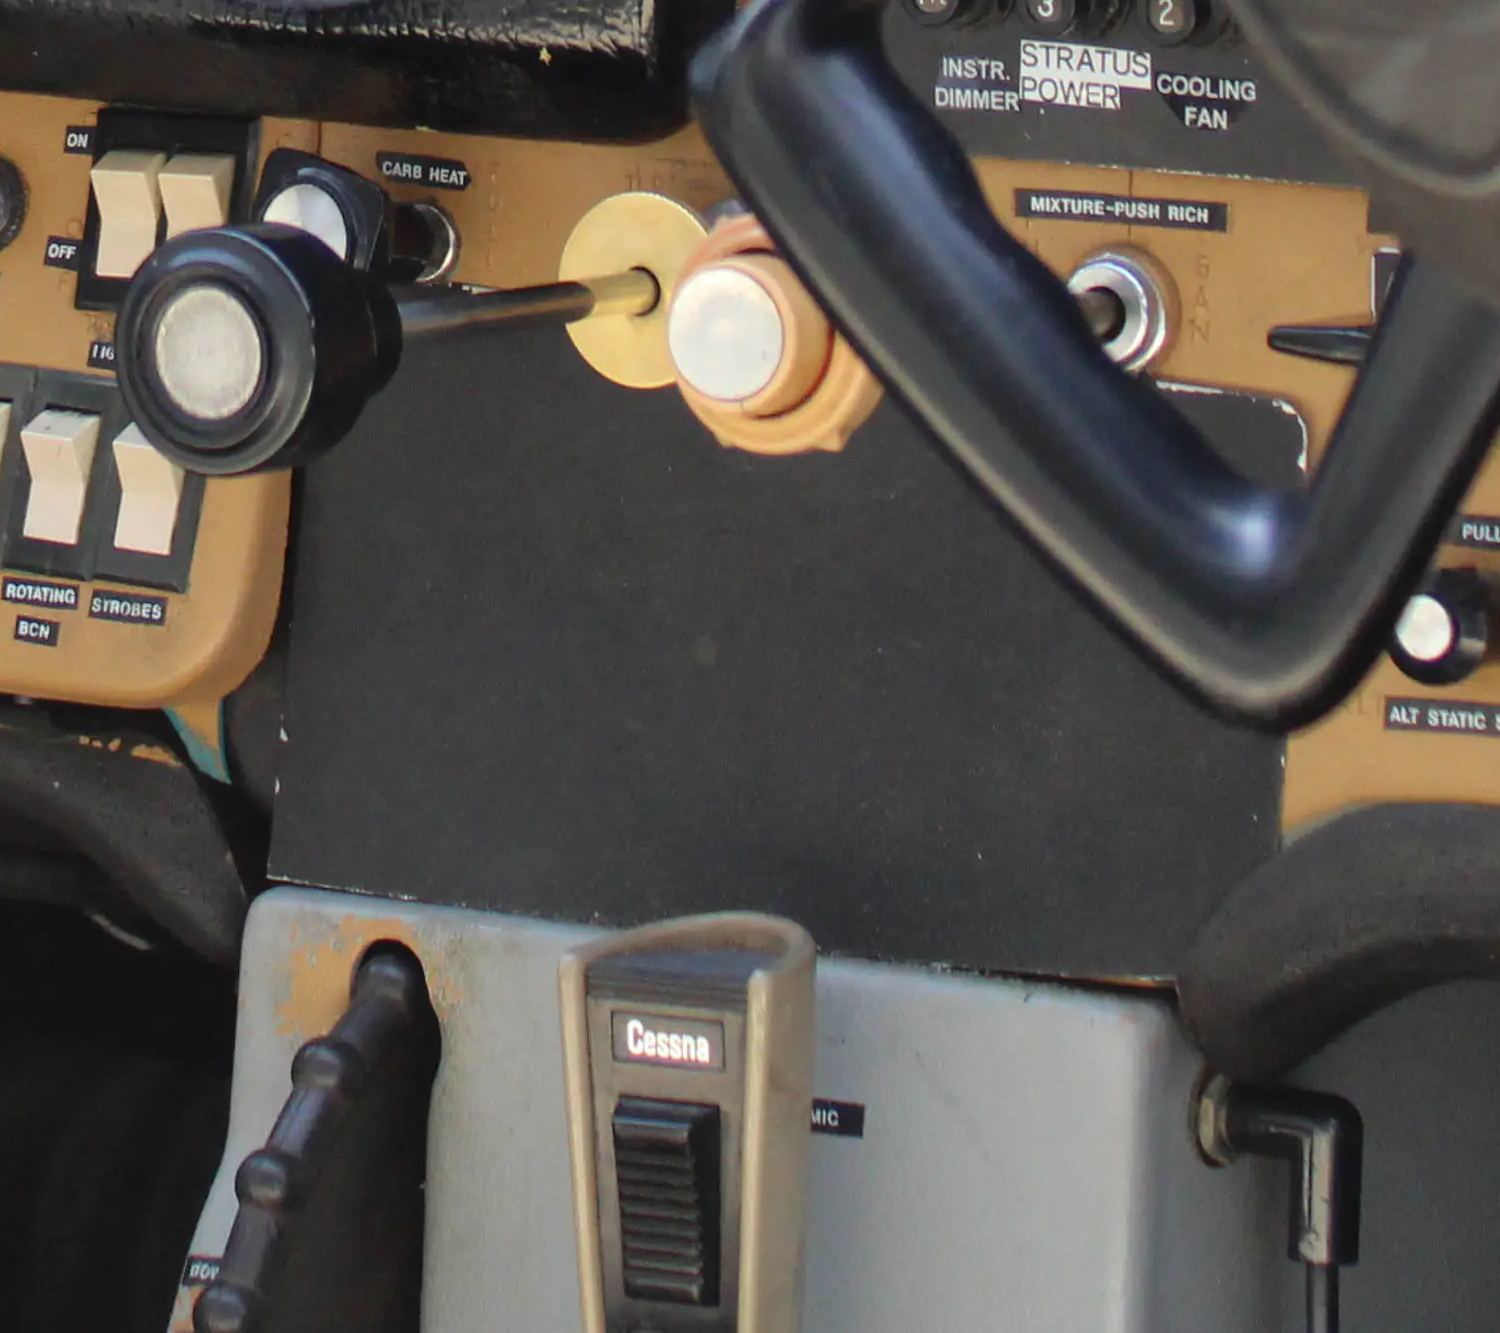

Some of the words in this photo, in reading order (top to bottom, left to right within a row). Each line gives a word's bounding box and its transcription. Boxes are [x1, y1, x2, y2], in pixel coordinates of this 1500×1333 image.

[942, 56, 1010, 82] INSTR.
[1021, 43, 1150, 77] STRATUS
[934, 85, 1020, 112] DIMMER
[1021, 76, 1121, 108] POWER
[1156, 74, 1257, 102] COOLING
[1184, 105, 1228, 130] FAN
[382, 159, 423, 180] CARB
[428, 166, 467, 187] HEAT
[1030, 195, 1160, 220] MIXTURE-PUSH
[1168, 204, 1209, 224] RICH
[47, 244, 76, 260] OFF
[5, 583, 76, 606] ROTATING
[91, 597, 163, 620] STROBES
[18, 620, 50, 639] BCN
[1389, 706, 1420, 727] ALT
[1428, 710, 1485, 731] STATIC
[626, 1019, 711, 1064] Cessna
